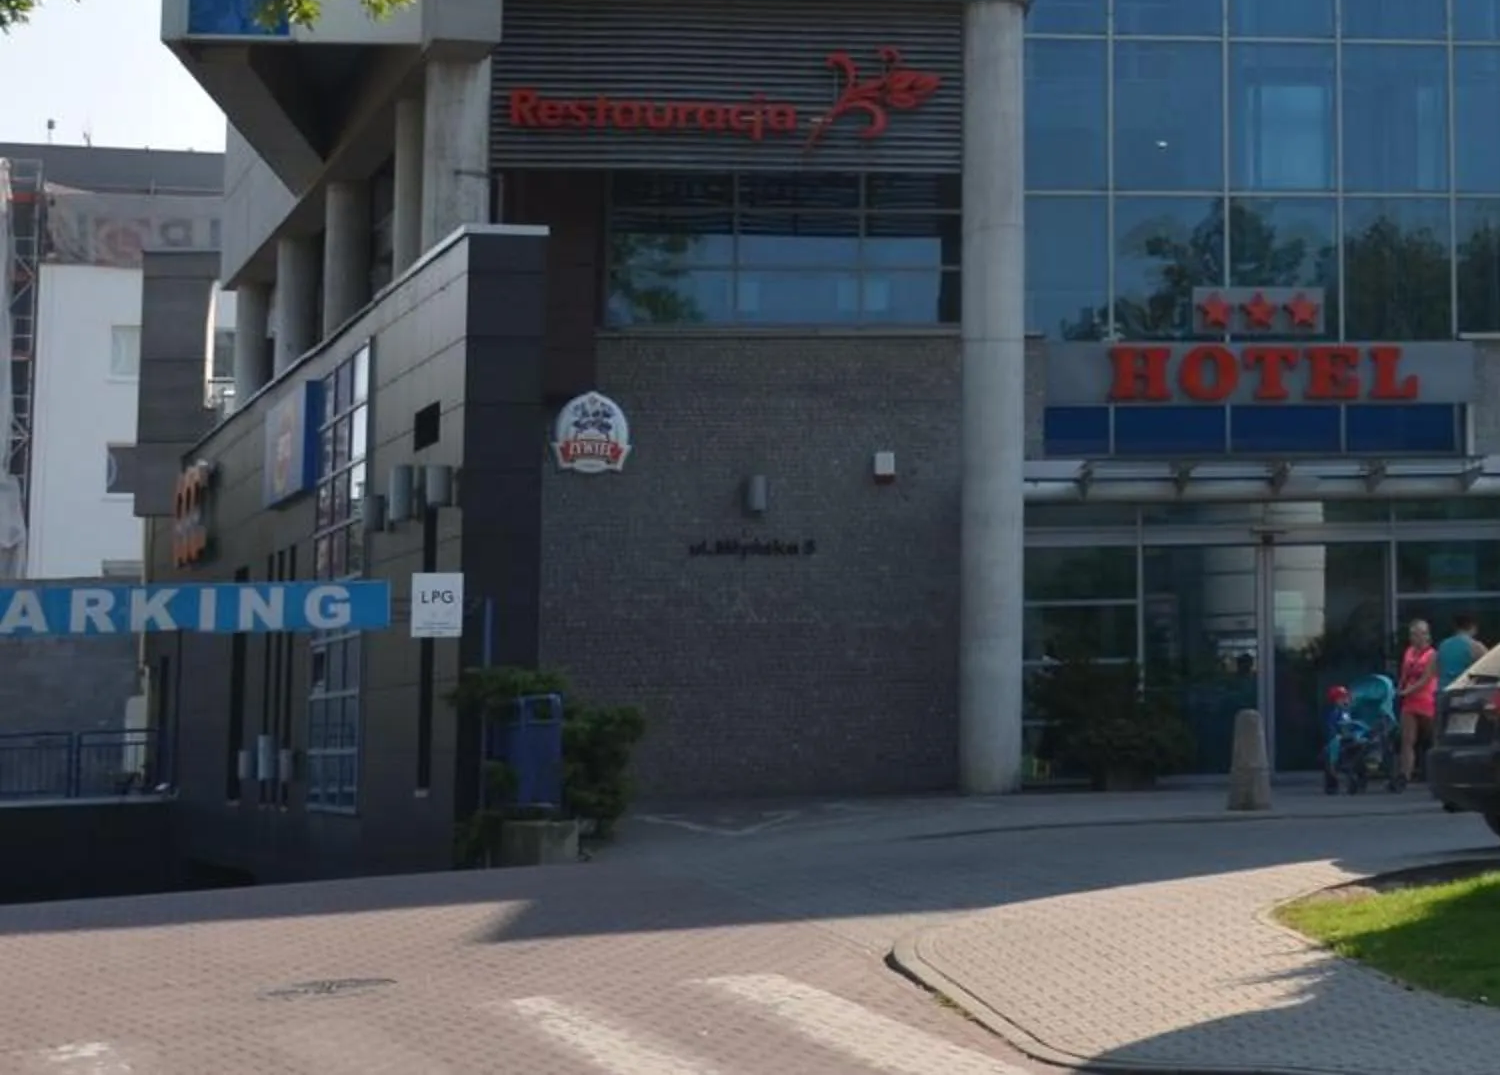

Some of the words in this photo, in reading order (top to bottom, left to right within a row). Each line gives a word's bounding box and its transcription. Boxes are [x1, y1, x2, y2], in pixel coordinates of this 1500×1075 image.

[509, 88, 797, 141] Restauracja
[1109, 346, 1419, 400] HOTEL
[420, 589, 455, 605] LPG
